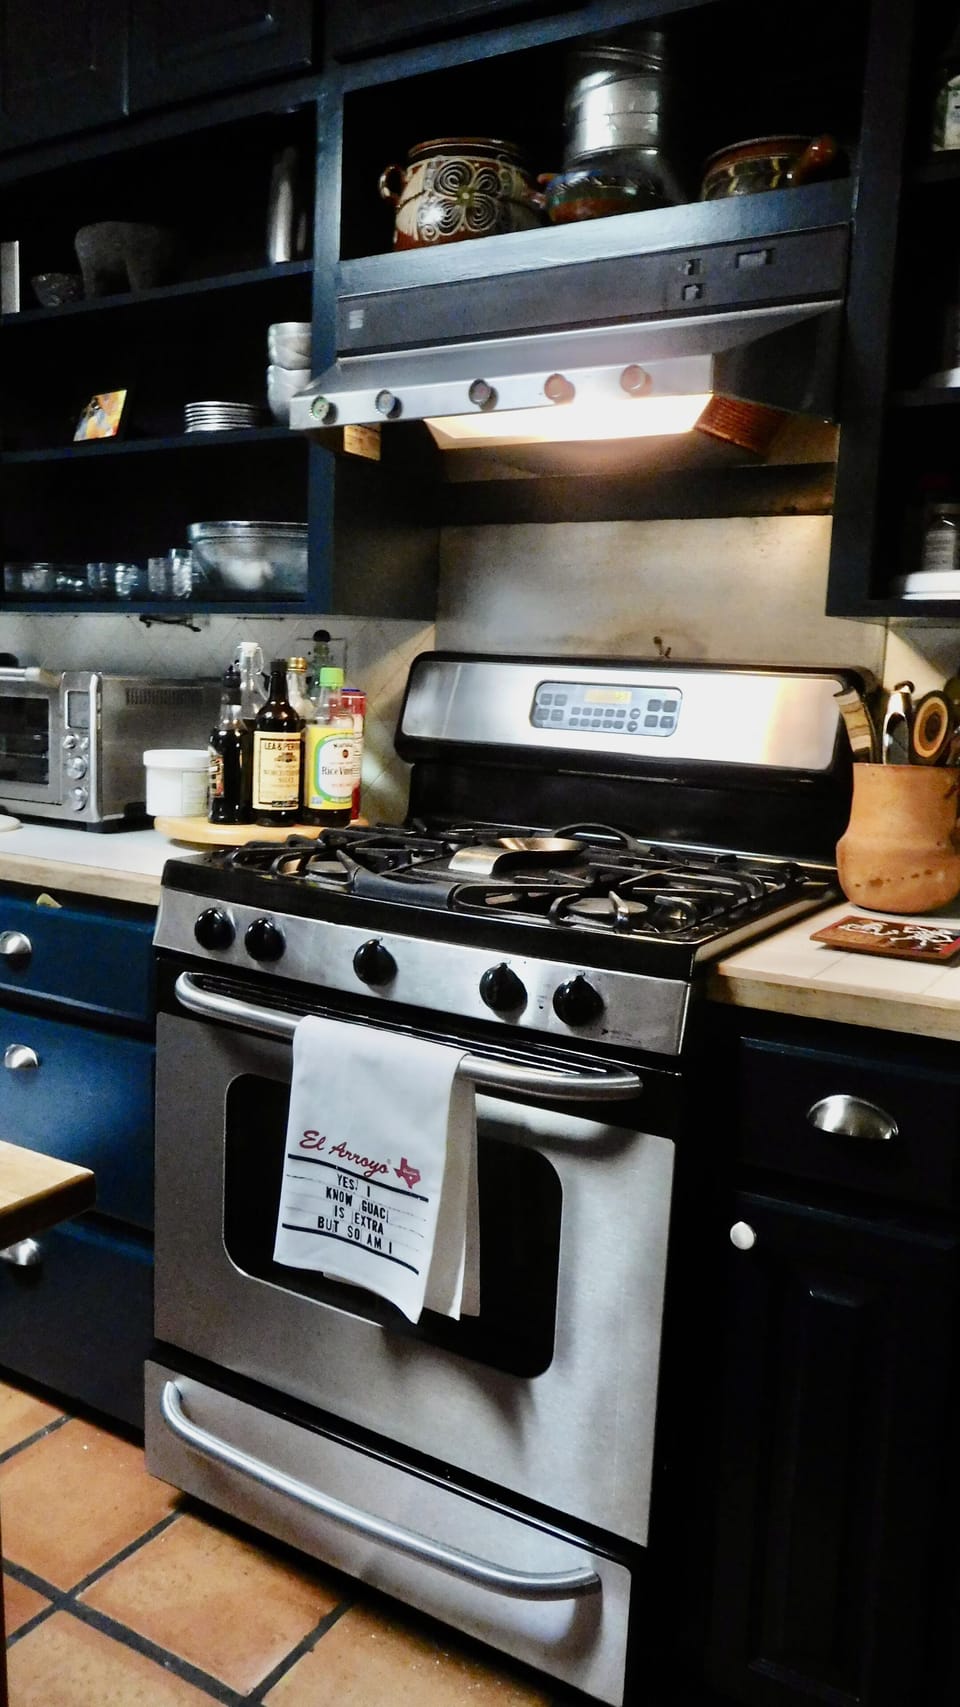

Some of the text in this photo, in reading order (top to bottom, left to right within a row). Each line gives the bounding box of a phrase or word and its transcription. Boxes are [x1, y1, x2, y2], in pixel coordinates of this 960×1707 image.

[299, 1130, 389, 1178] El Arroyo
[326, 1186, 386, 1220] KNOW GUAC
[334, 1205, 384, 1235] IS EXTRA
[317, 1216, 340, 1233] BUT
[347, 1225, 360, 1240] SO
[367, 1233, 382, 1250] AM
